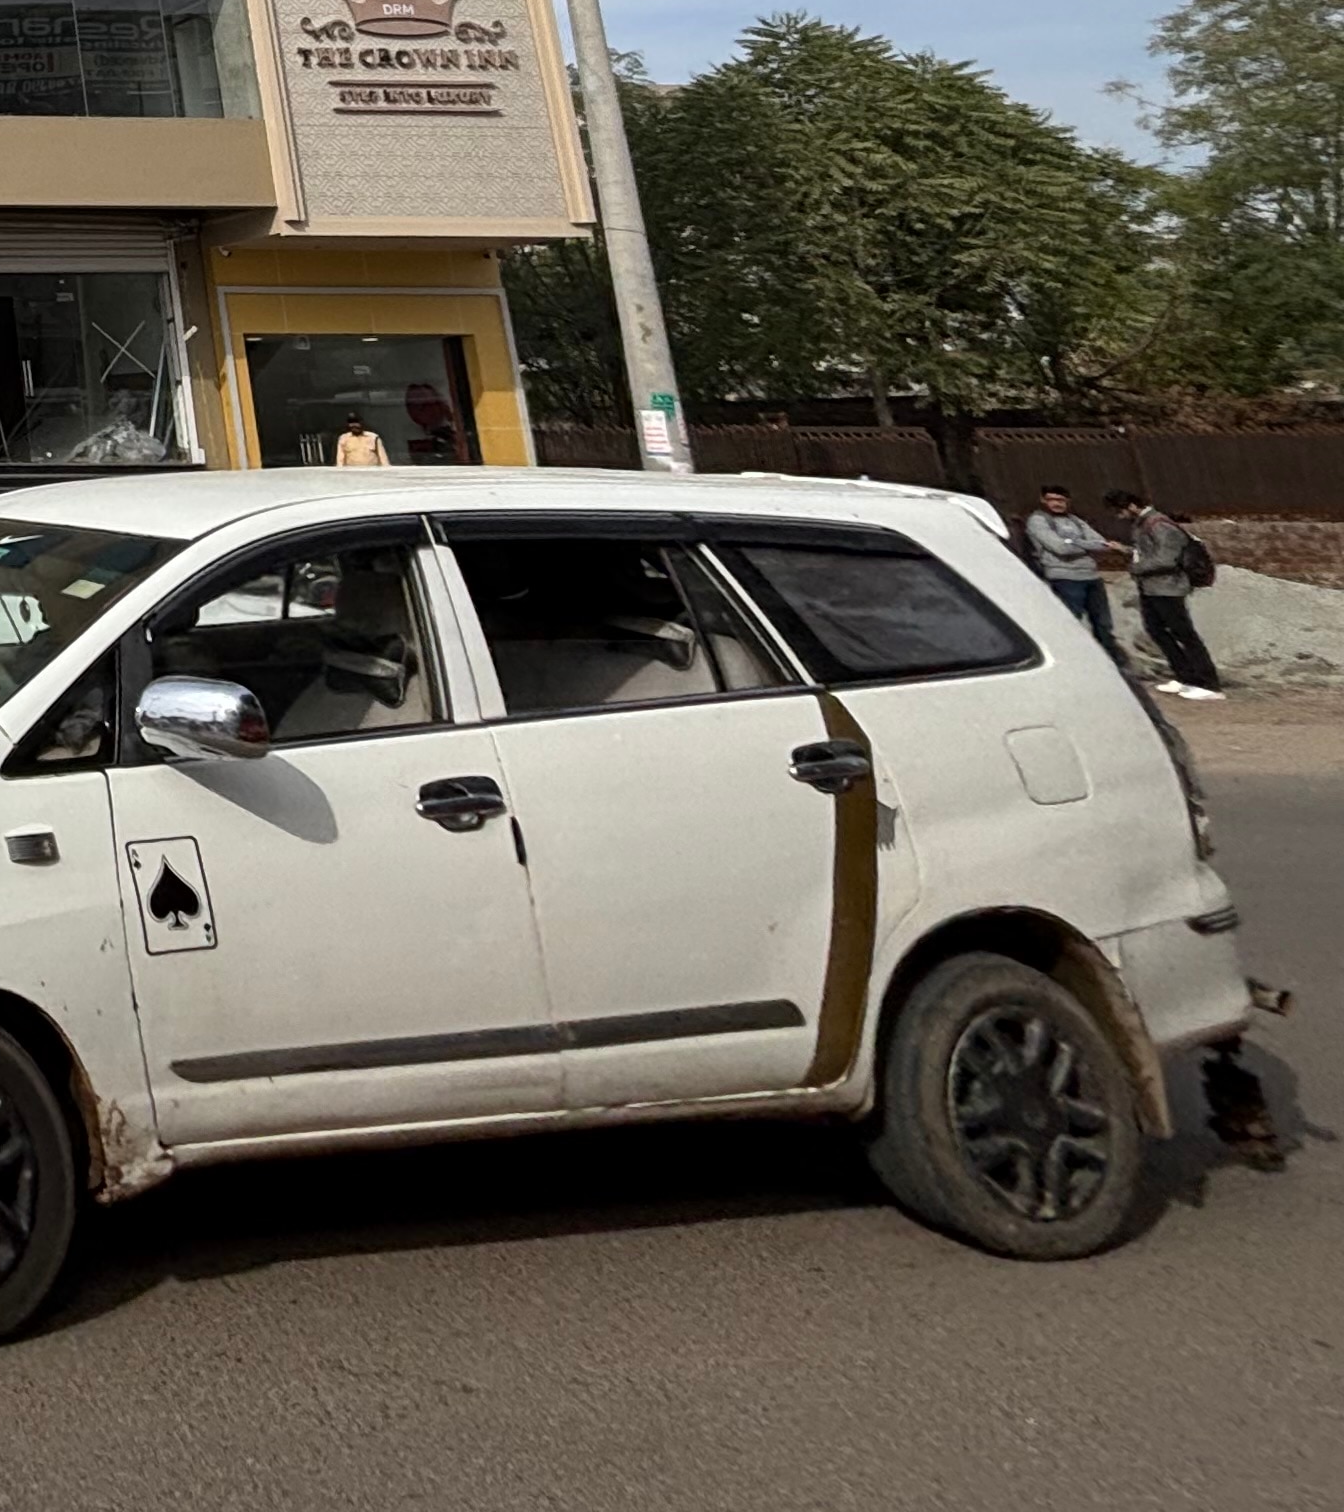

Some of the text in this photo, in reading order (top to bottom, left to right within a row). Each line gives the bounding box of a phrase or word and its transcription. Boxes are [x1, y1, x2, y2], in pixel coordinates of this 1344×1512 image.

[382, 3, 415, 15] DRM
[297, 47, 521, 70] THE CROWN INN
